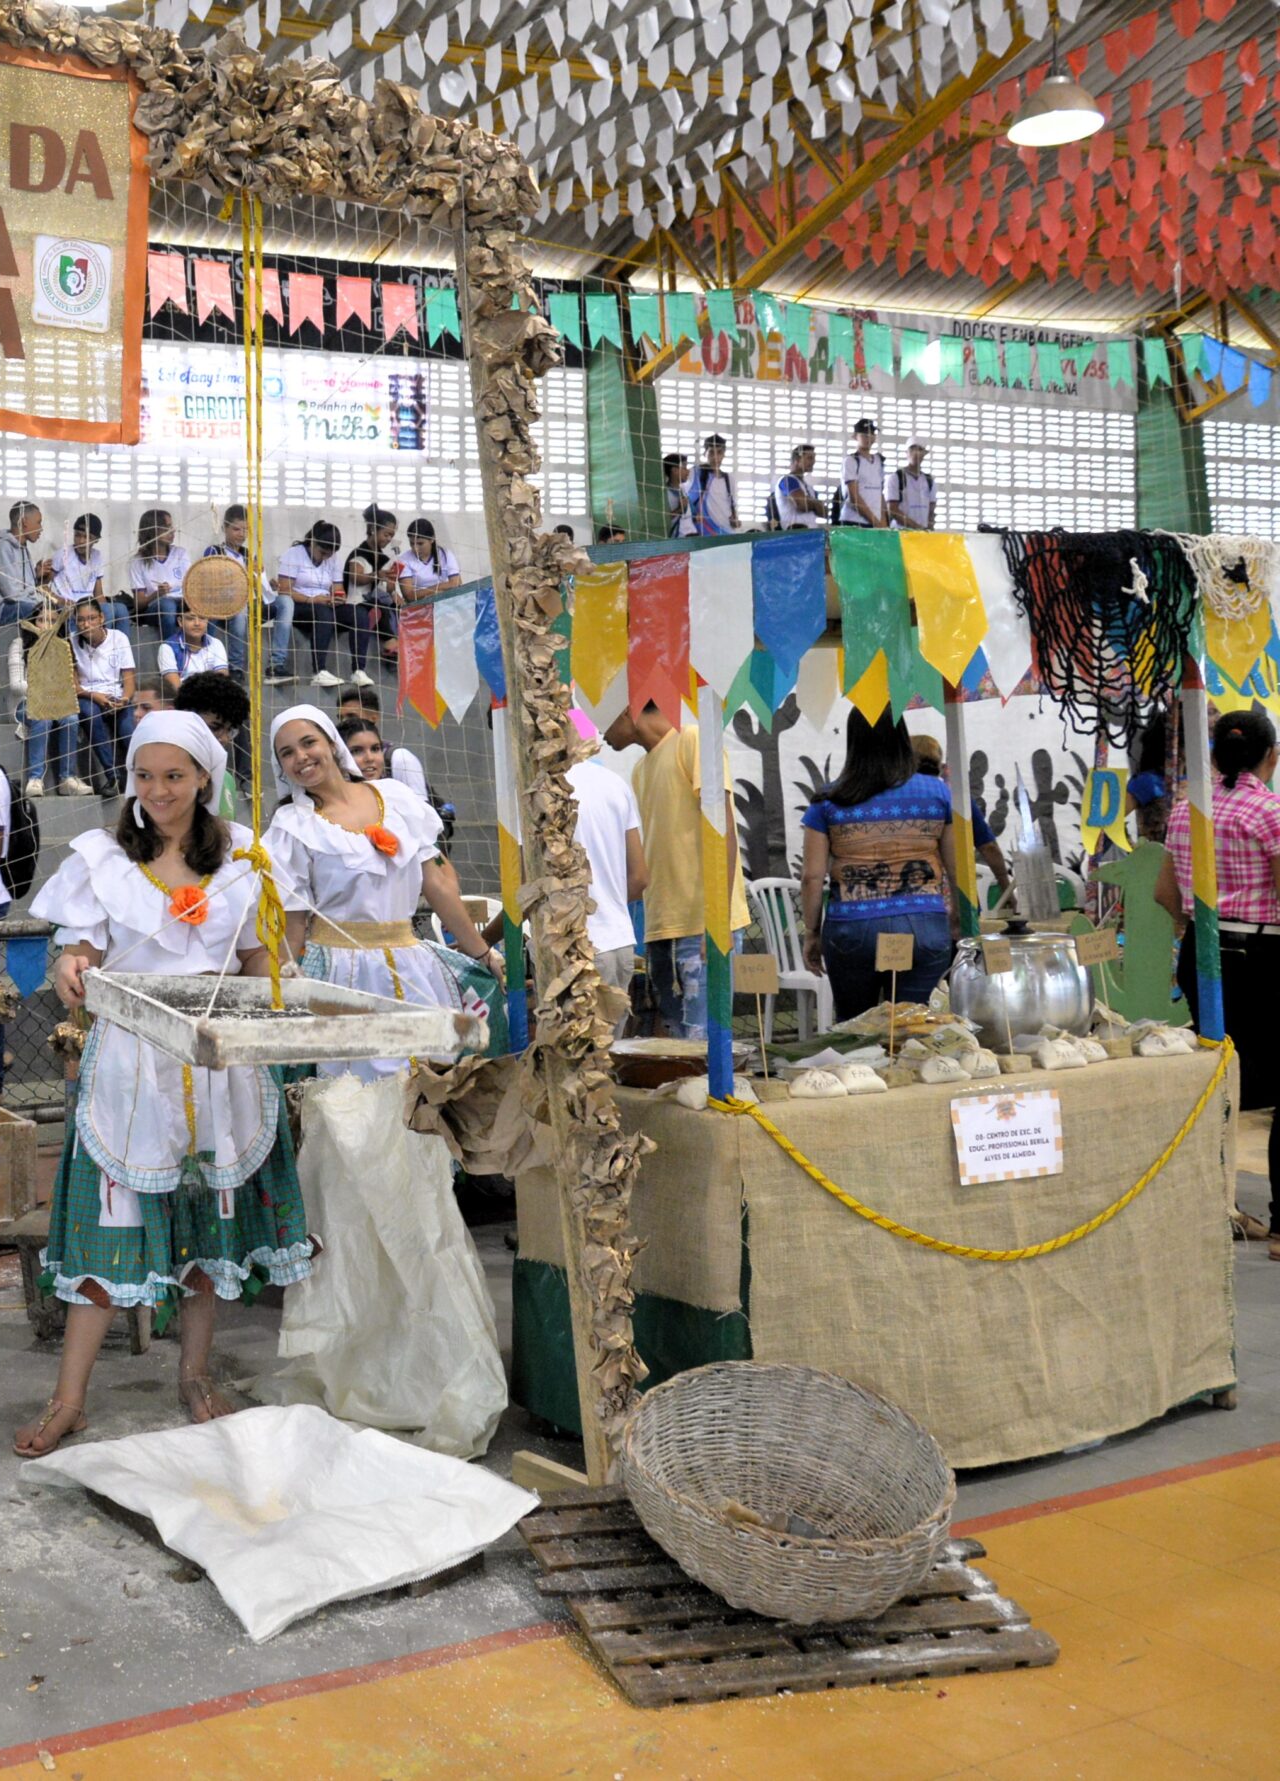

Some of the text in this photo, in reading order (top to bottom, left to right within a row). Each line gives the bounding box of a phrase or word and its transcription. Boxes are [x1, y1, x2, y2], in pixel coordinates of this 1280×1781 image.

[9, 122, 115, 200] DA
[297, 414, 382, 441] Milho
[1086, 771, 1120, 828] D
[987, 1130, 1010, 1140] CENTRO
[1010, 1129, 1019, 1138] DE
[1019, 1128, 1032, 1137] EXC.
[1033, 1127, 1042, 1135] DE
[969, 1144, 987, 1153] EDUC.
[988, 1140, 1029, 1151] PROFISSIONAL
[984, 1150, 1036, 1162] ALVES DE ALMEIDA
